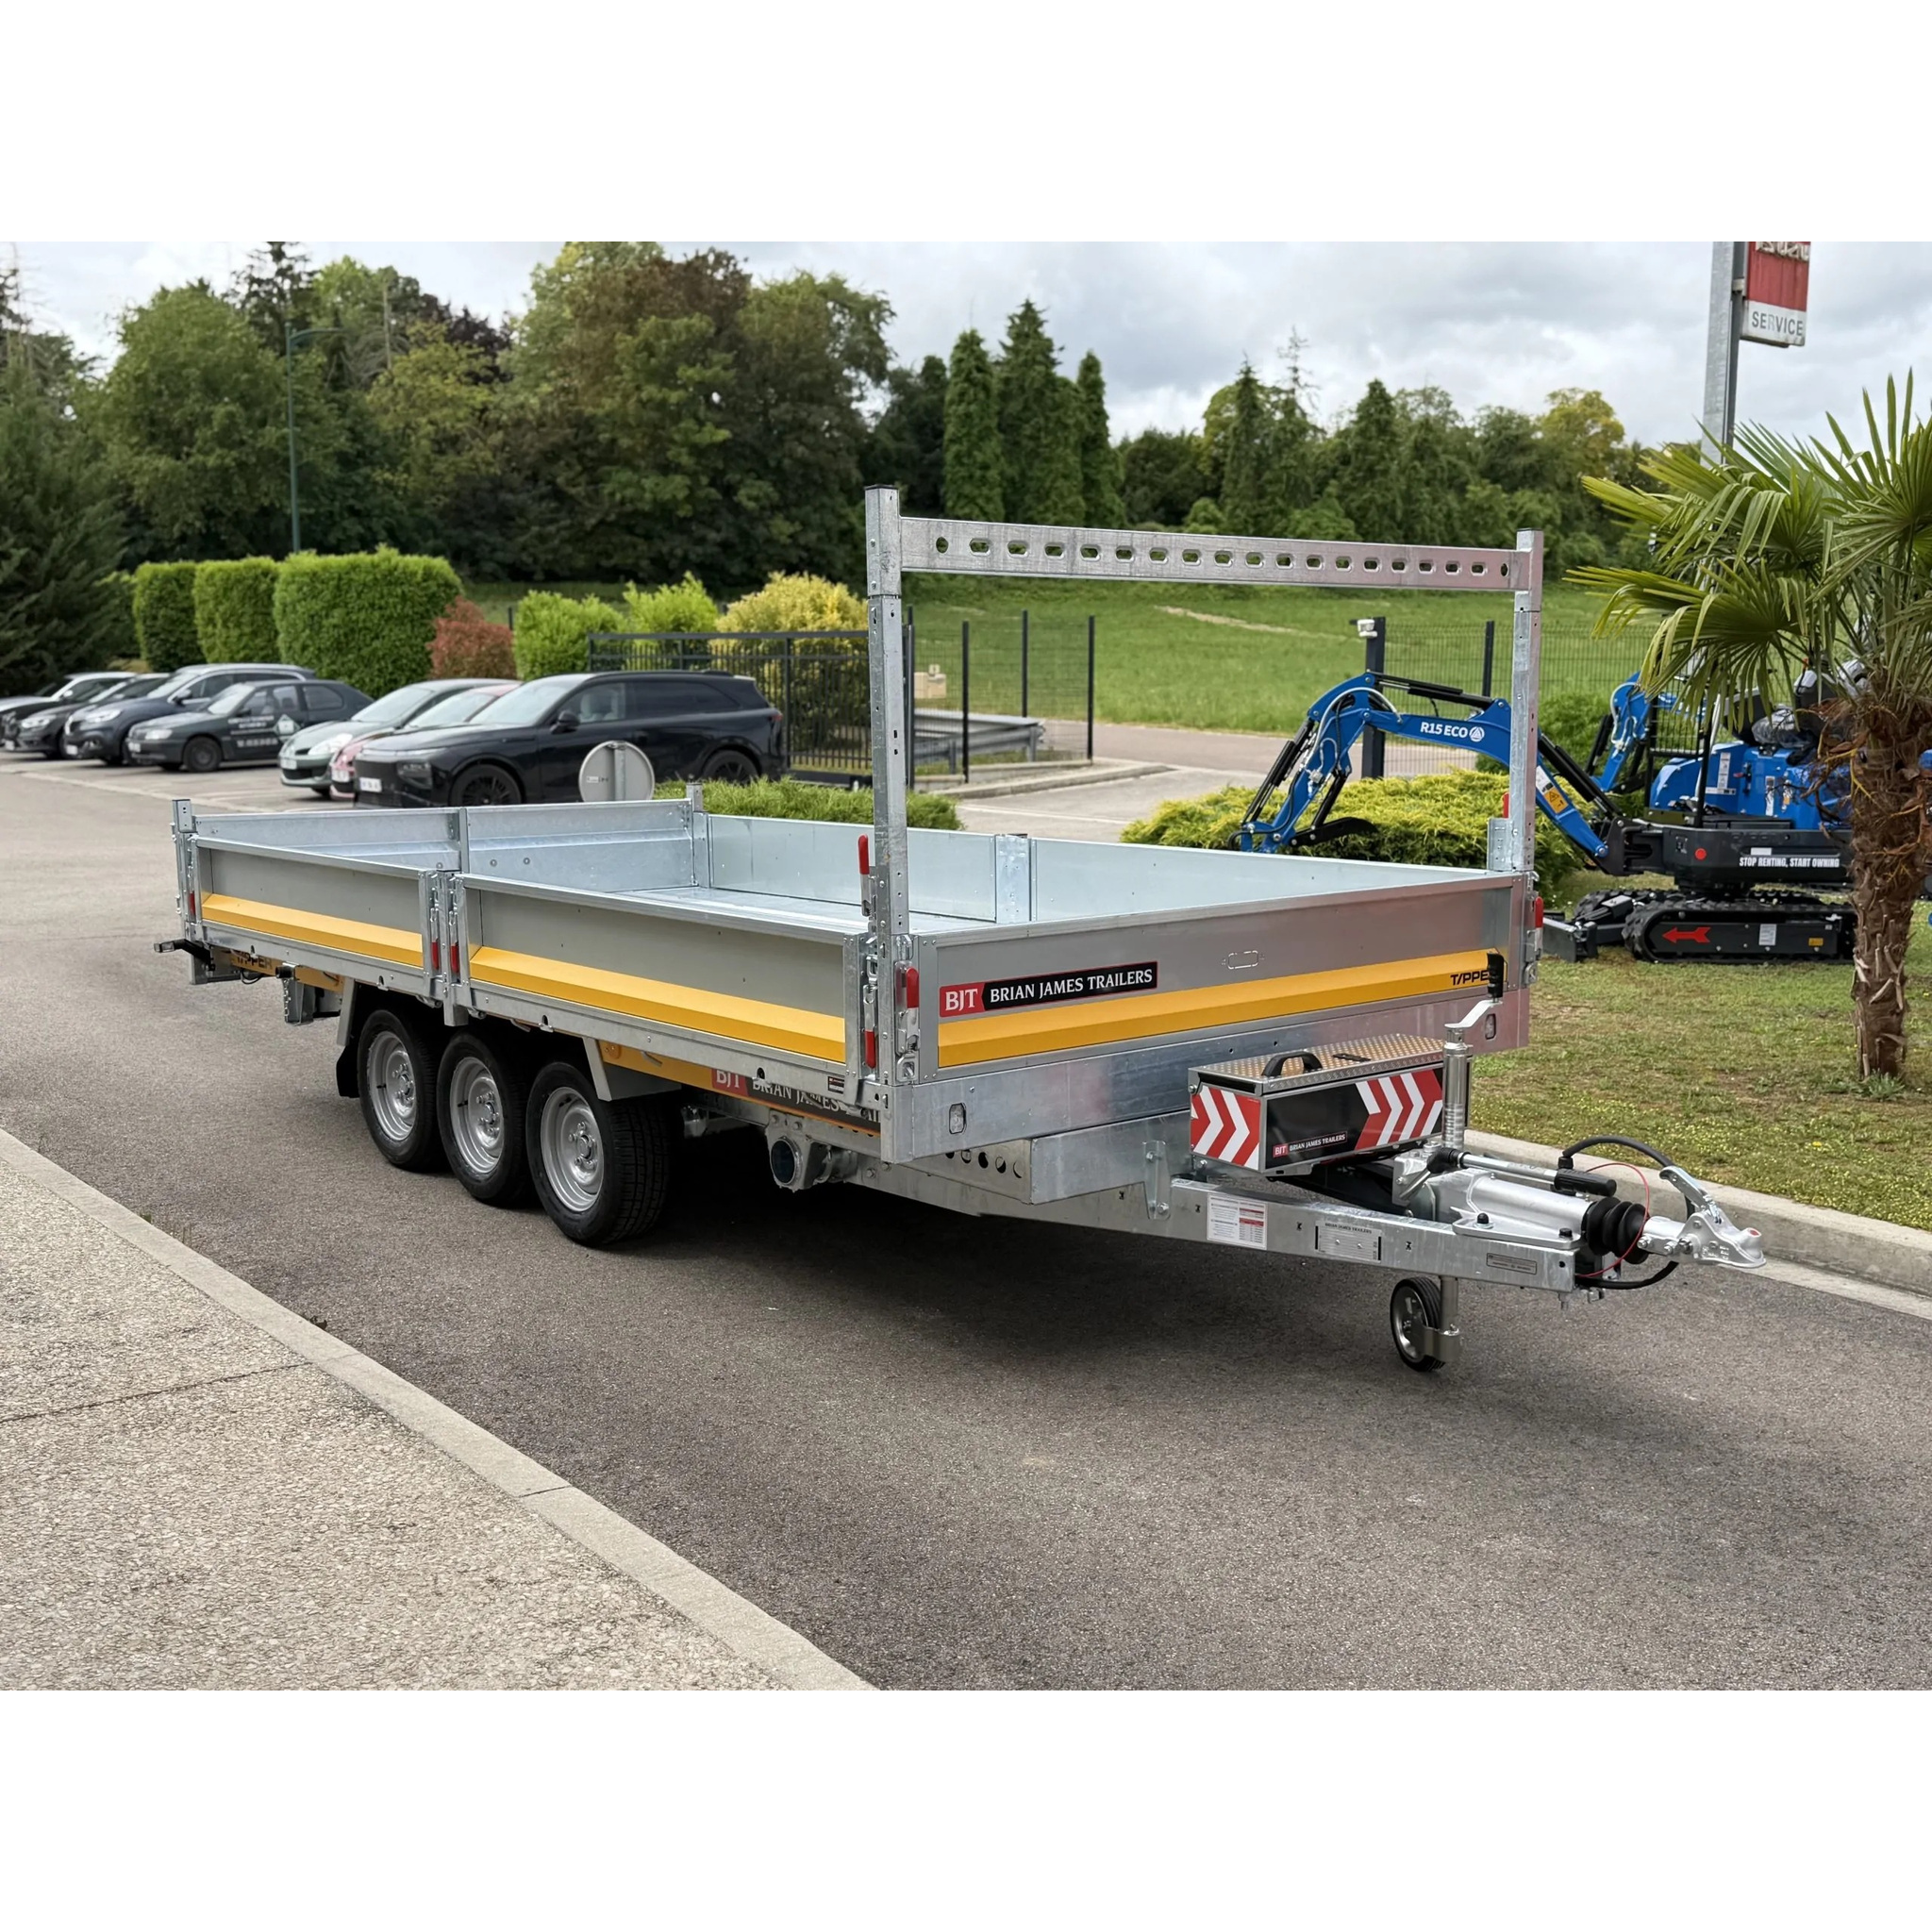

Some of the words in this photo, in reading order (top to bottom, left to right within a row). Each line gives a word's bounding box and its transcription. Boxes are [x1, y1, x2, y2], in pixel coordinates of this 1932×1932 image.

[1752, 311, 1804, 336] SERVICE
[1420, 722, 1443, 735] R15
[1443, 724, 1469, 739] ECO
[1739, 857, 1757, 867] STOP
[1757, 858, 1789, 868] RENTING,
[1790, 858, 1811, 867] START
[1811, 858, 1840, 868] OWNING
[1450, 970, 1489, 985] TIPPE
[944, 988, 978, 1011] BJT
[990, 983, 1035, 1003] BRIAN
[1039, 977, 1084, 999] JAMES
[1087, 969, 1153, 990] TRAILERS
[1290, 1142, 1305, 1151] BRIAN
[1306, 1139, 1322, 1148] JAMES
[1322, 1134, 1346, 1144] TRAILERS
